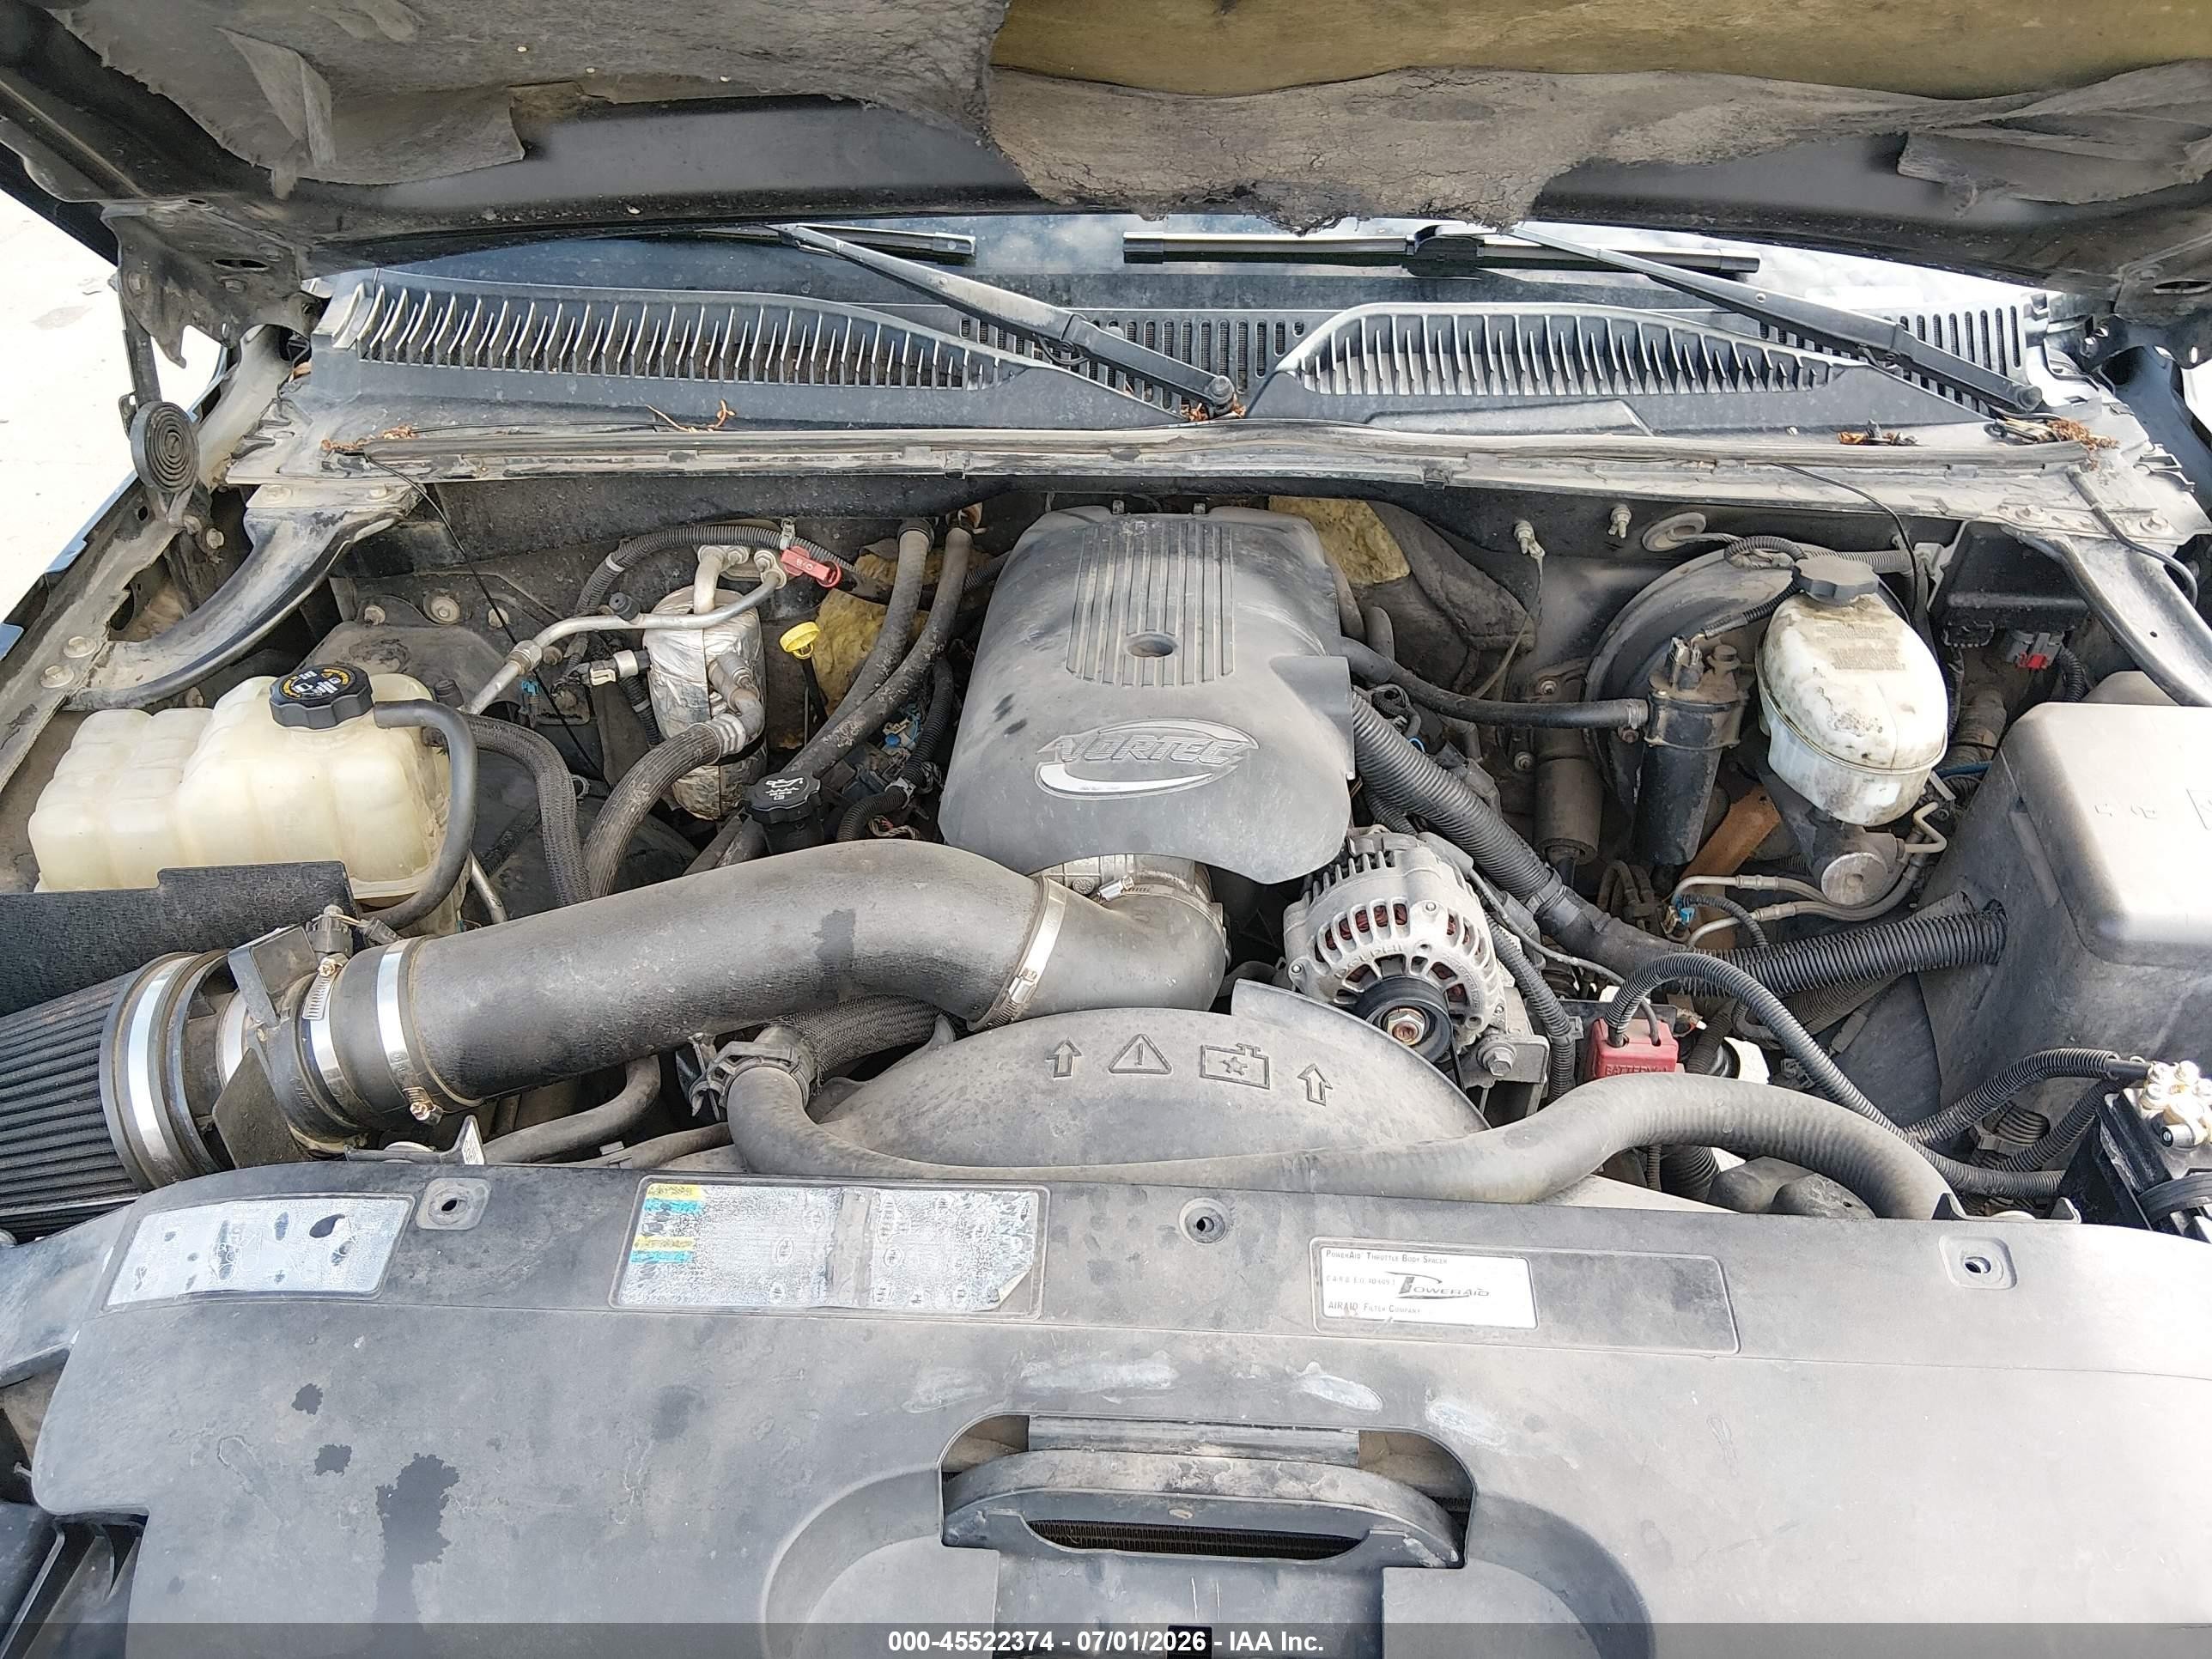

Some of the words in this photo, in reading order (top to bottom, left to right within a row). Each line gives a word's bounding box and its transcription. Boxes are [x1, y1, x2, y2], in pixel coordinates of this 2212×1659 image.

[1055, 735, 1243, 765] VORTEC
[1402, 1254, 1420, 1263] BODY
[1328, 1301, 1358, 1311] AIRAID
